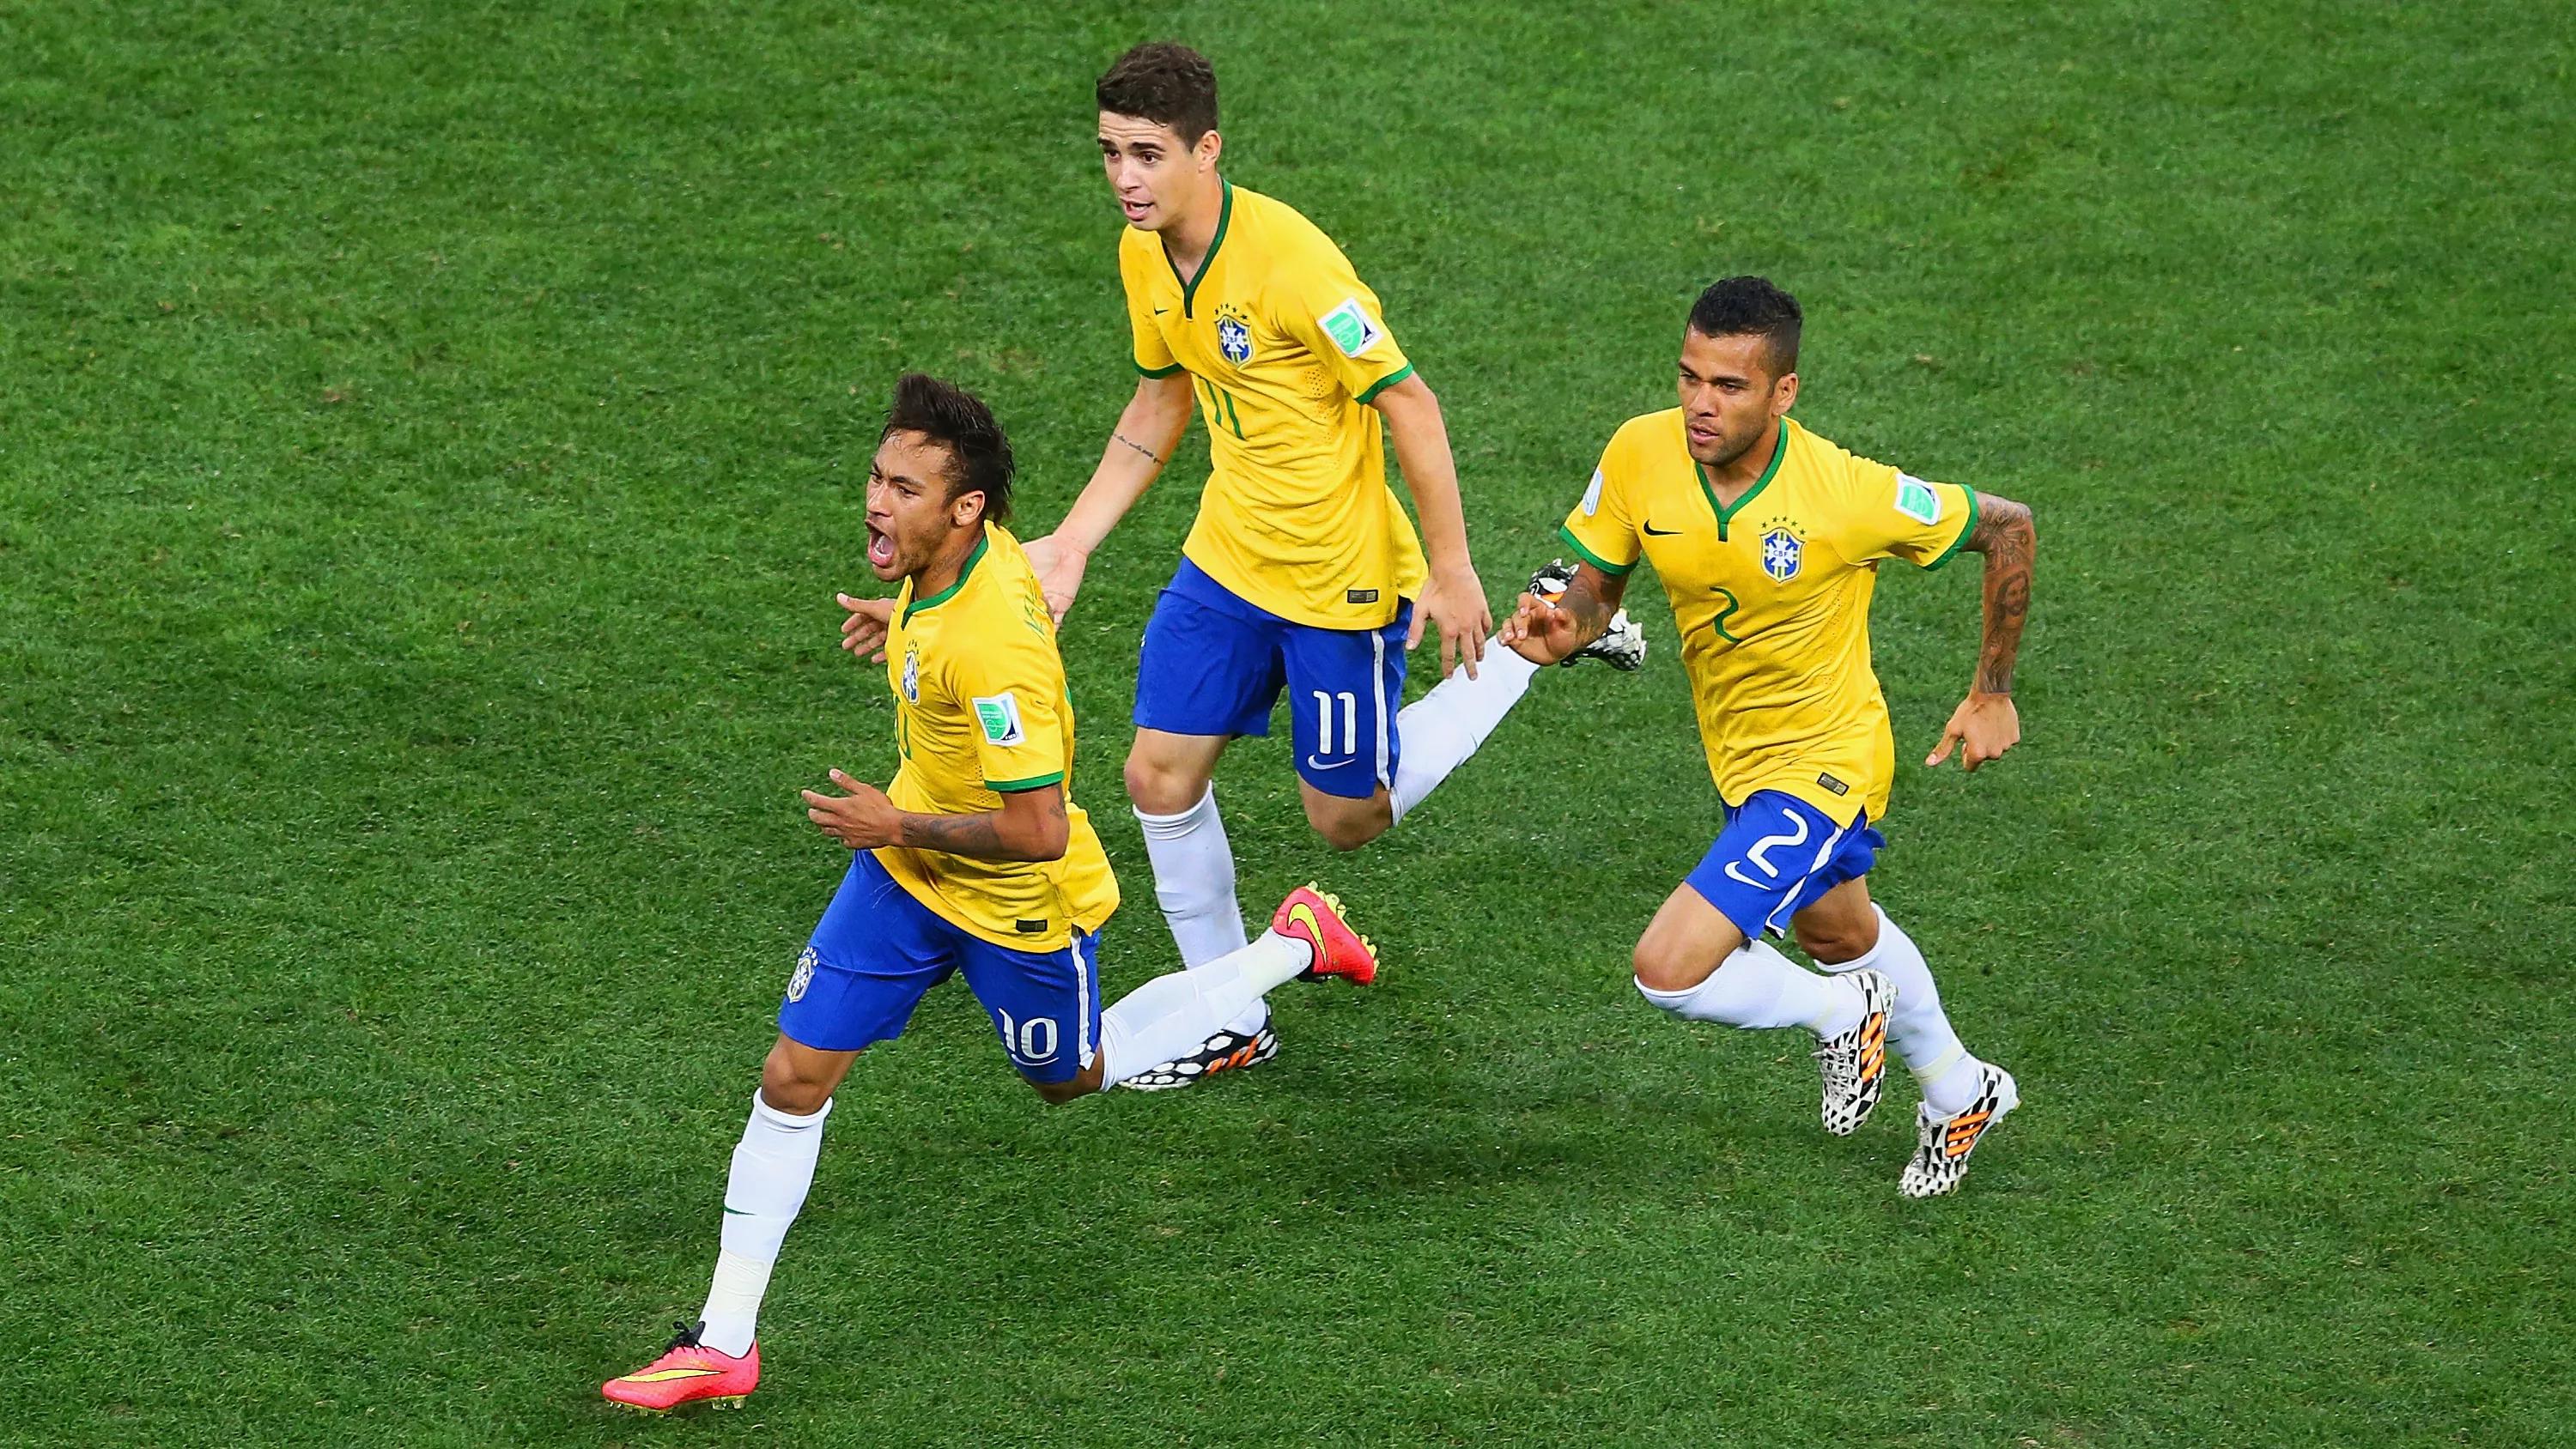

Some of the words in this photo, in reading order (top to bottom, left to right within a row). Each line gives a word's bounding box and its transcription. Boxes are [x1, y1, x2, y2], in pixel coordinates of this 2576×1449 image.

[1201, 378, 1245, 440] 11
[1710, 587, 1741, 644] 2
[1313, 690, 1356, 755] 11
[1747, 808, 1808, 878] 2
[999, 1008, 1058, 1059] 10
